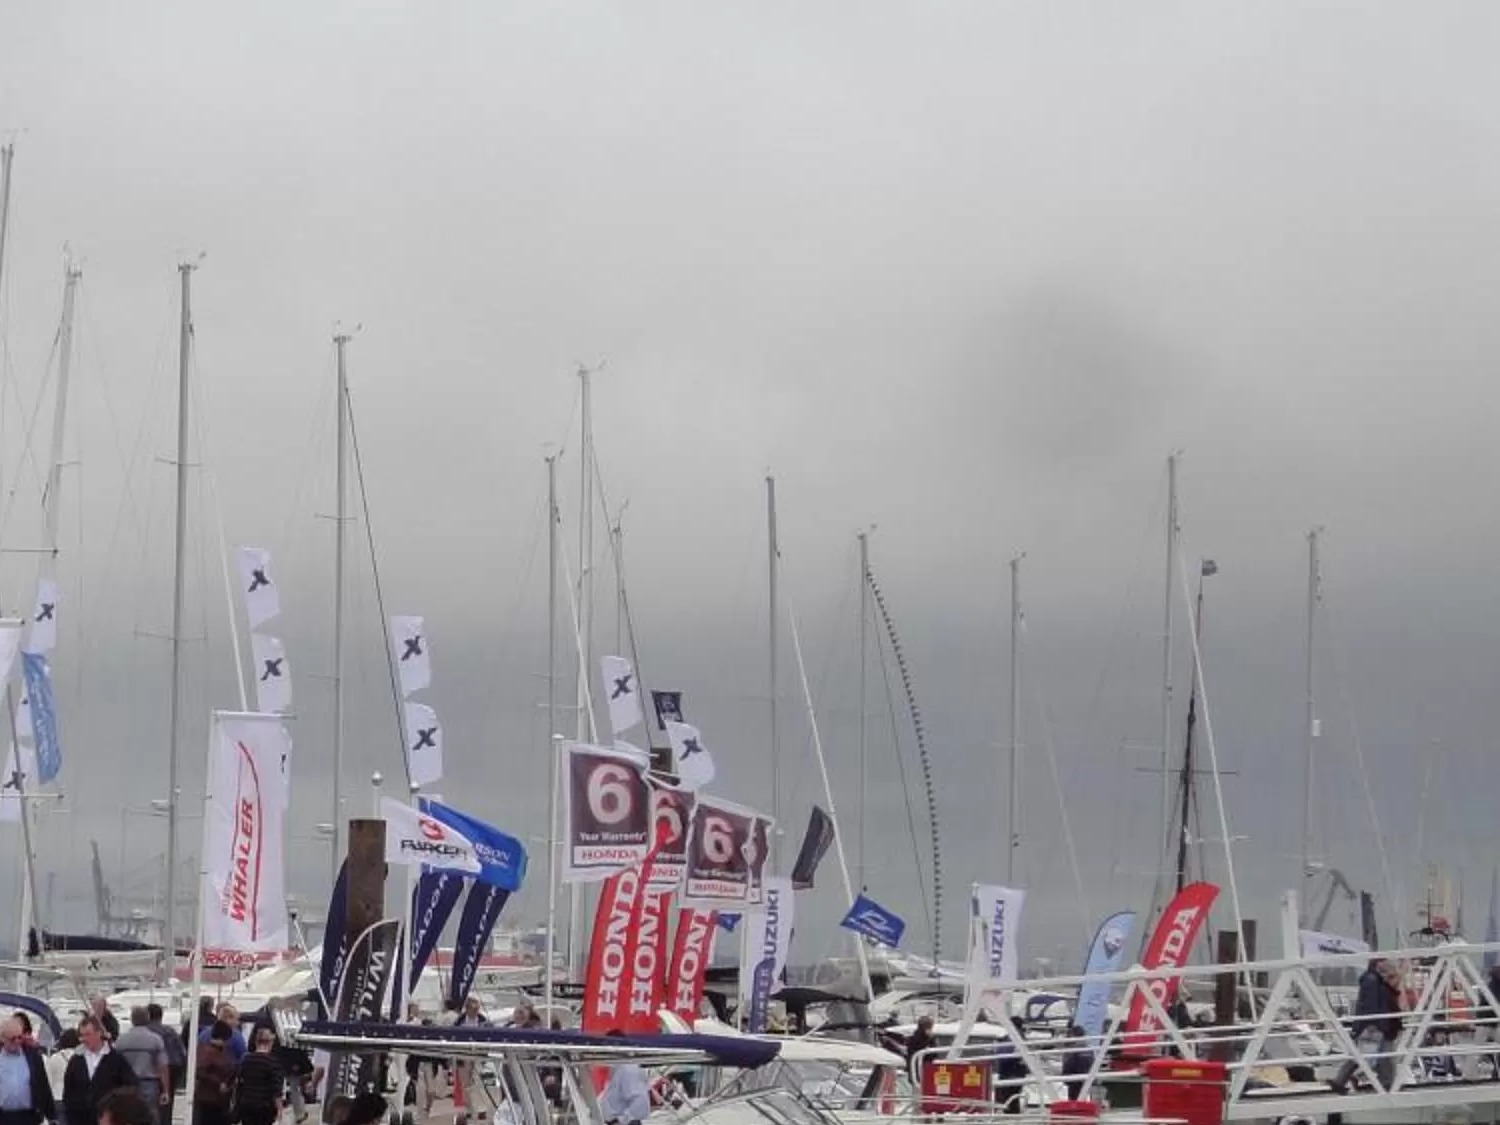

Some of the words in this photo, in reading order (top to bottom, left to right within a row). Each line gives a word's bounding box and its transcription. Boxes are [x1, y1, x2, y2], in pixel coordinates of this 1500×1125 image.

[587, 763, 632, 825] 6
[230, 798, 254, 922] WHALER
[702, 815, 734, 863] 6
[596, 868, 638, 1018] HOND
[674, 908, 711, 1013] HON
[764, 888, 781, 955] UZUKI
[988, 898, 1006, 977] SUZUKI
